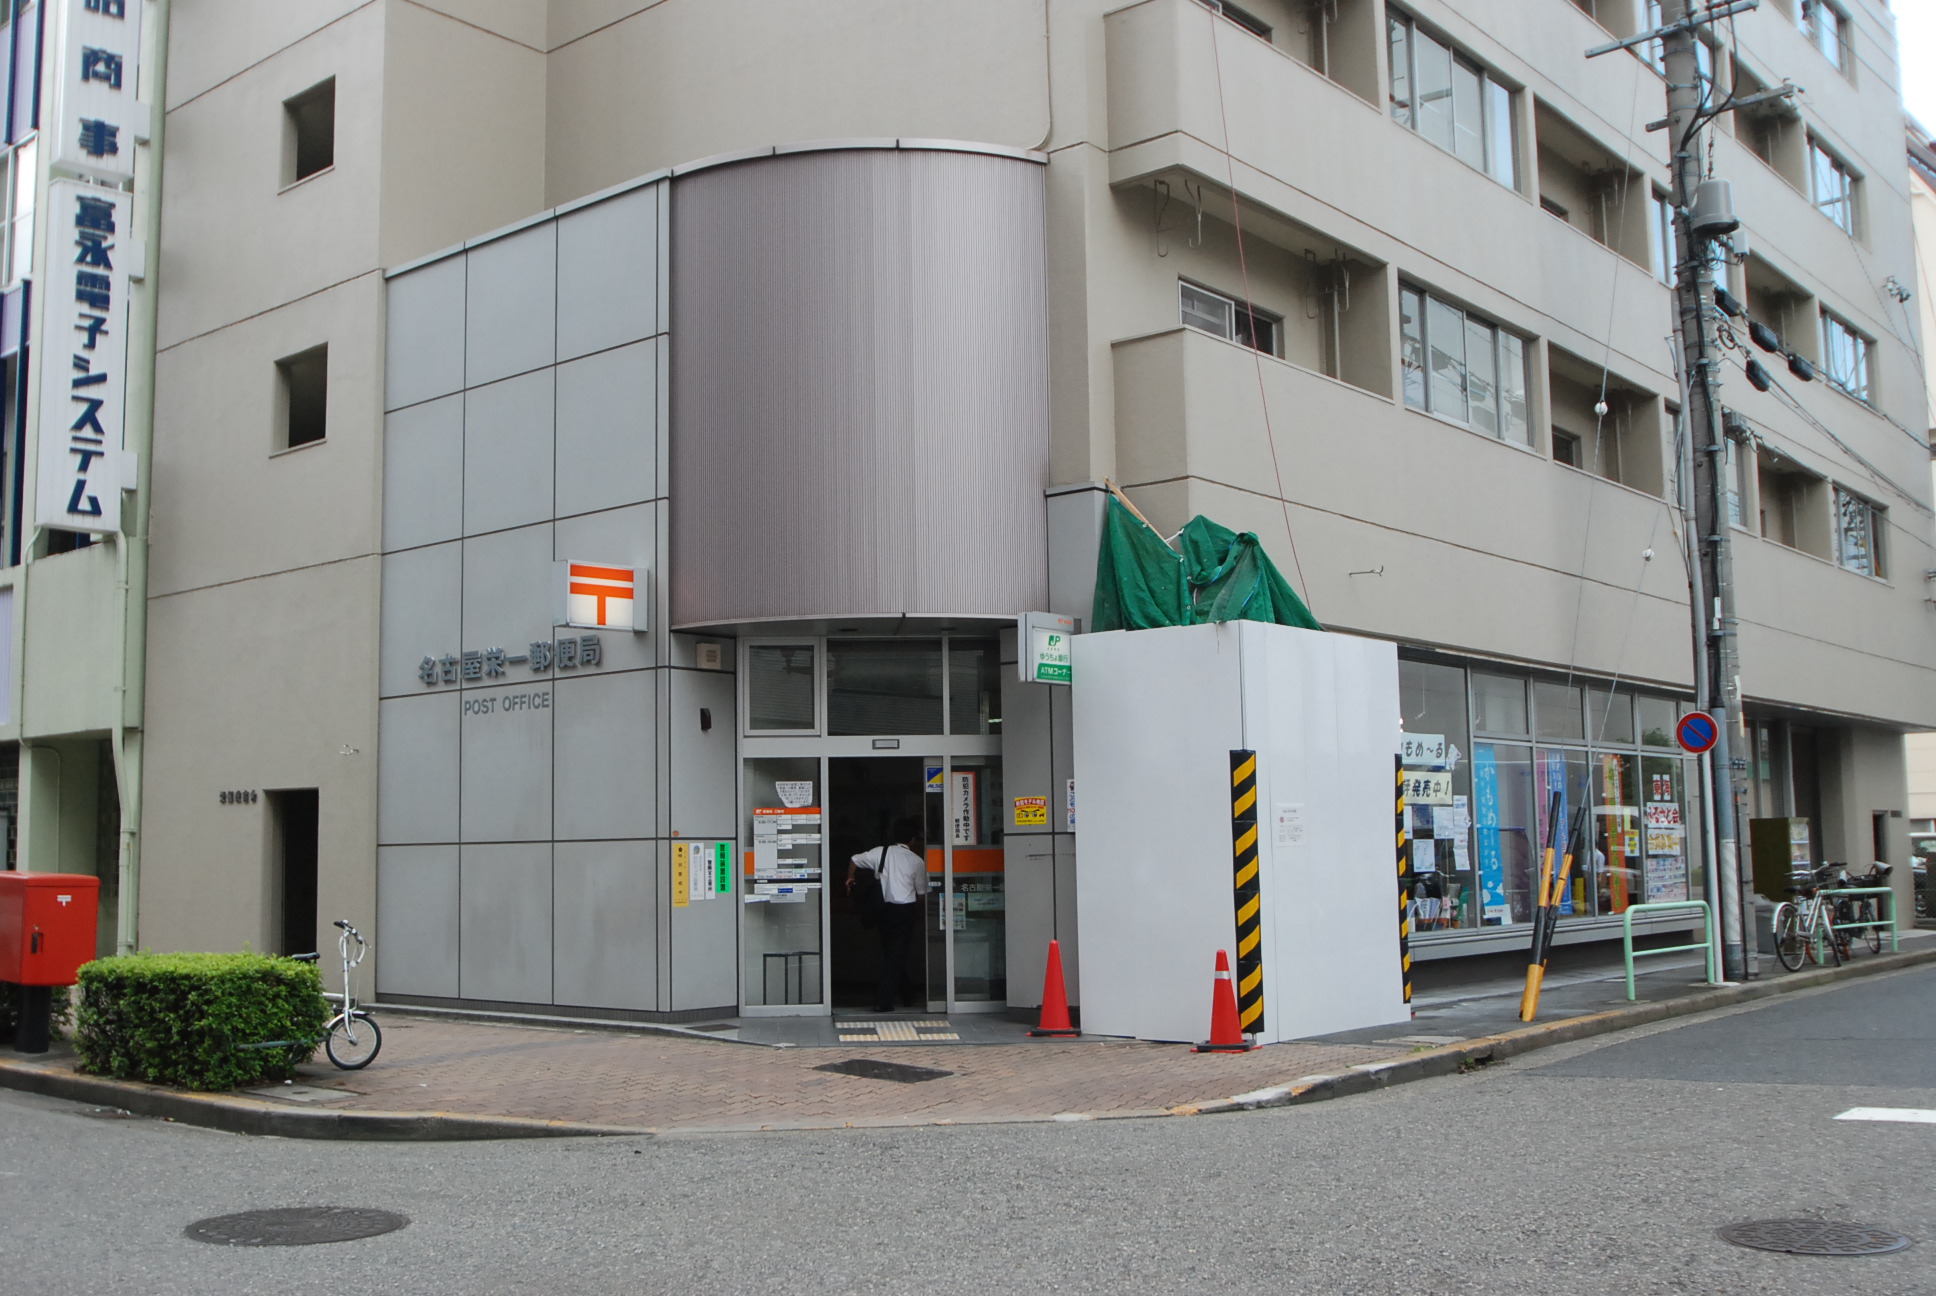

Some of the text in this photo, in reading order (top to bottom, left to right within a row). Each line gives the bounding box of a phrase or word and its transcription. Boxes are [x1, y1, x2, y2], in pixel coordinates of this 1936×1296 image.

[67, 194, 116, 516] 富永電子システム
[418, 634, 602, 685] 名古屋栄一郵便局
[1040, 653, 1068, 663] ゆうちょ銀行
[464, 692, 550, 715] POST OFFICE
[1400, 740, 1443, 759] もめ～る
[962, 776, 970, 843] 防犯カメラ作動中です
